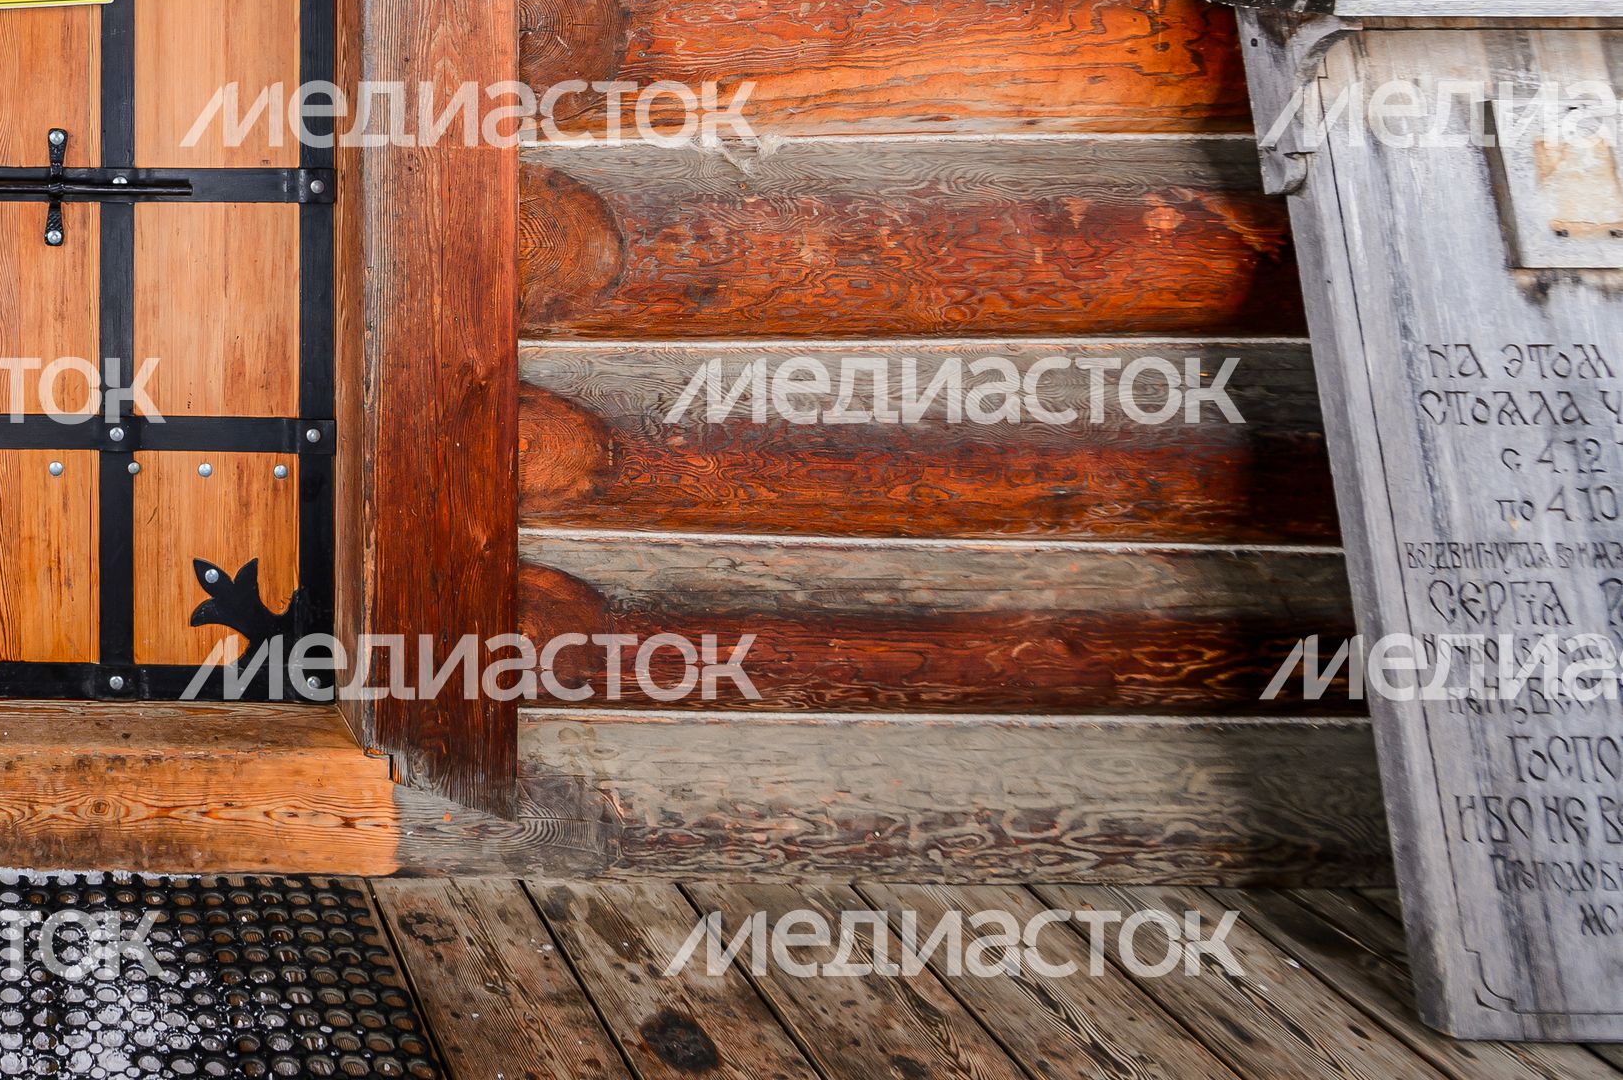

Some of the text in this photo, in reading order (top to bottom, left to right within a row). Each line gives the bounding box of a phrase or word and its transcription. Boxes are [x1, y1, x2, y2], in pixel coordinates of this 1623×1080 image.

[1426, 344, 1616, 378] НА ЭТОМ
[1542, 794, 1590, 847] НЕ
